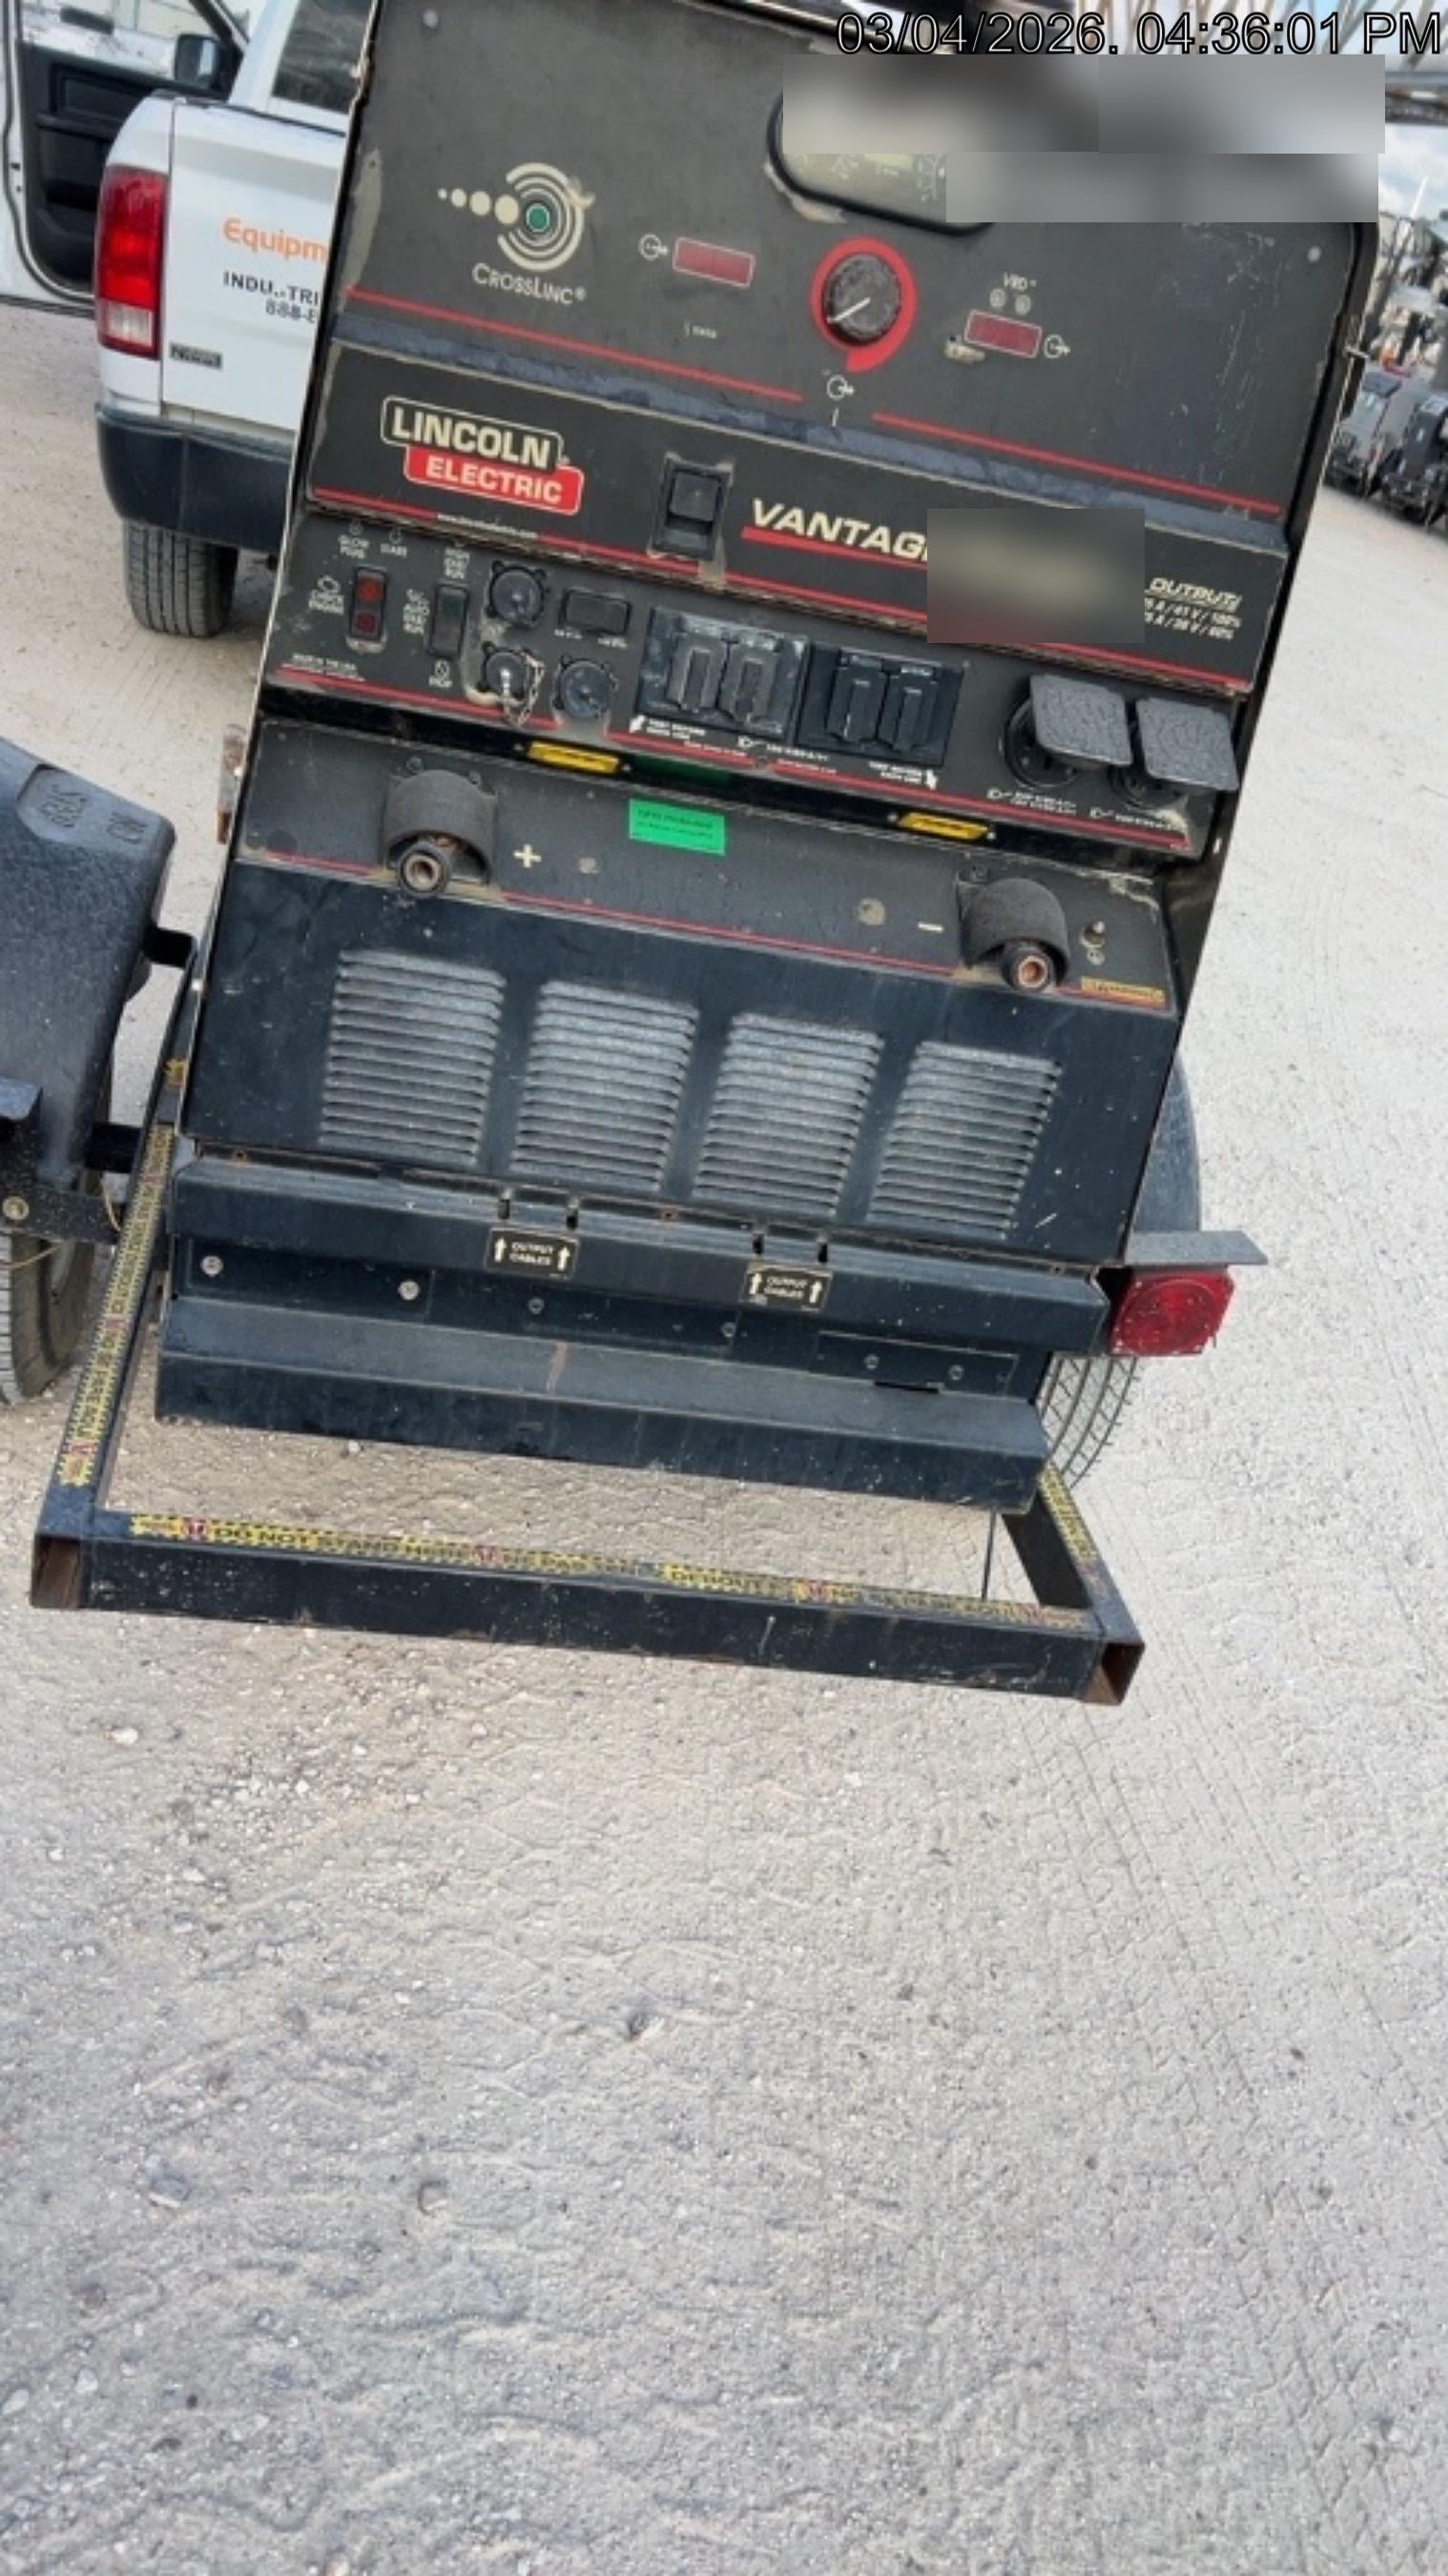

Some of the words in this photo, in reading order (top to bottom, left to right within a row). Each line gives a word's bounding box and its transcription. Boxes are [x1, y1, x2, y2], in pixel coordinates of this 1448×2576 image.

[223, 218, 330, 262] Equipm
[223, 271, 319, 305] INDUTRI
[392, 406, 551, 469] LINCOLN
[425, 454, 563, 505] ELECTRIC
[753, 496, 927, 562] VANTAG
